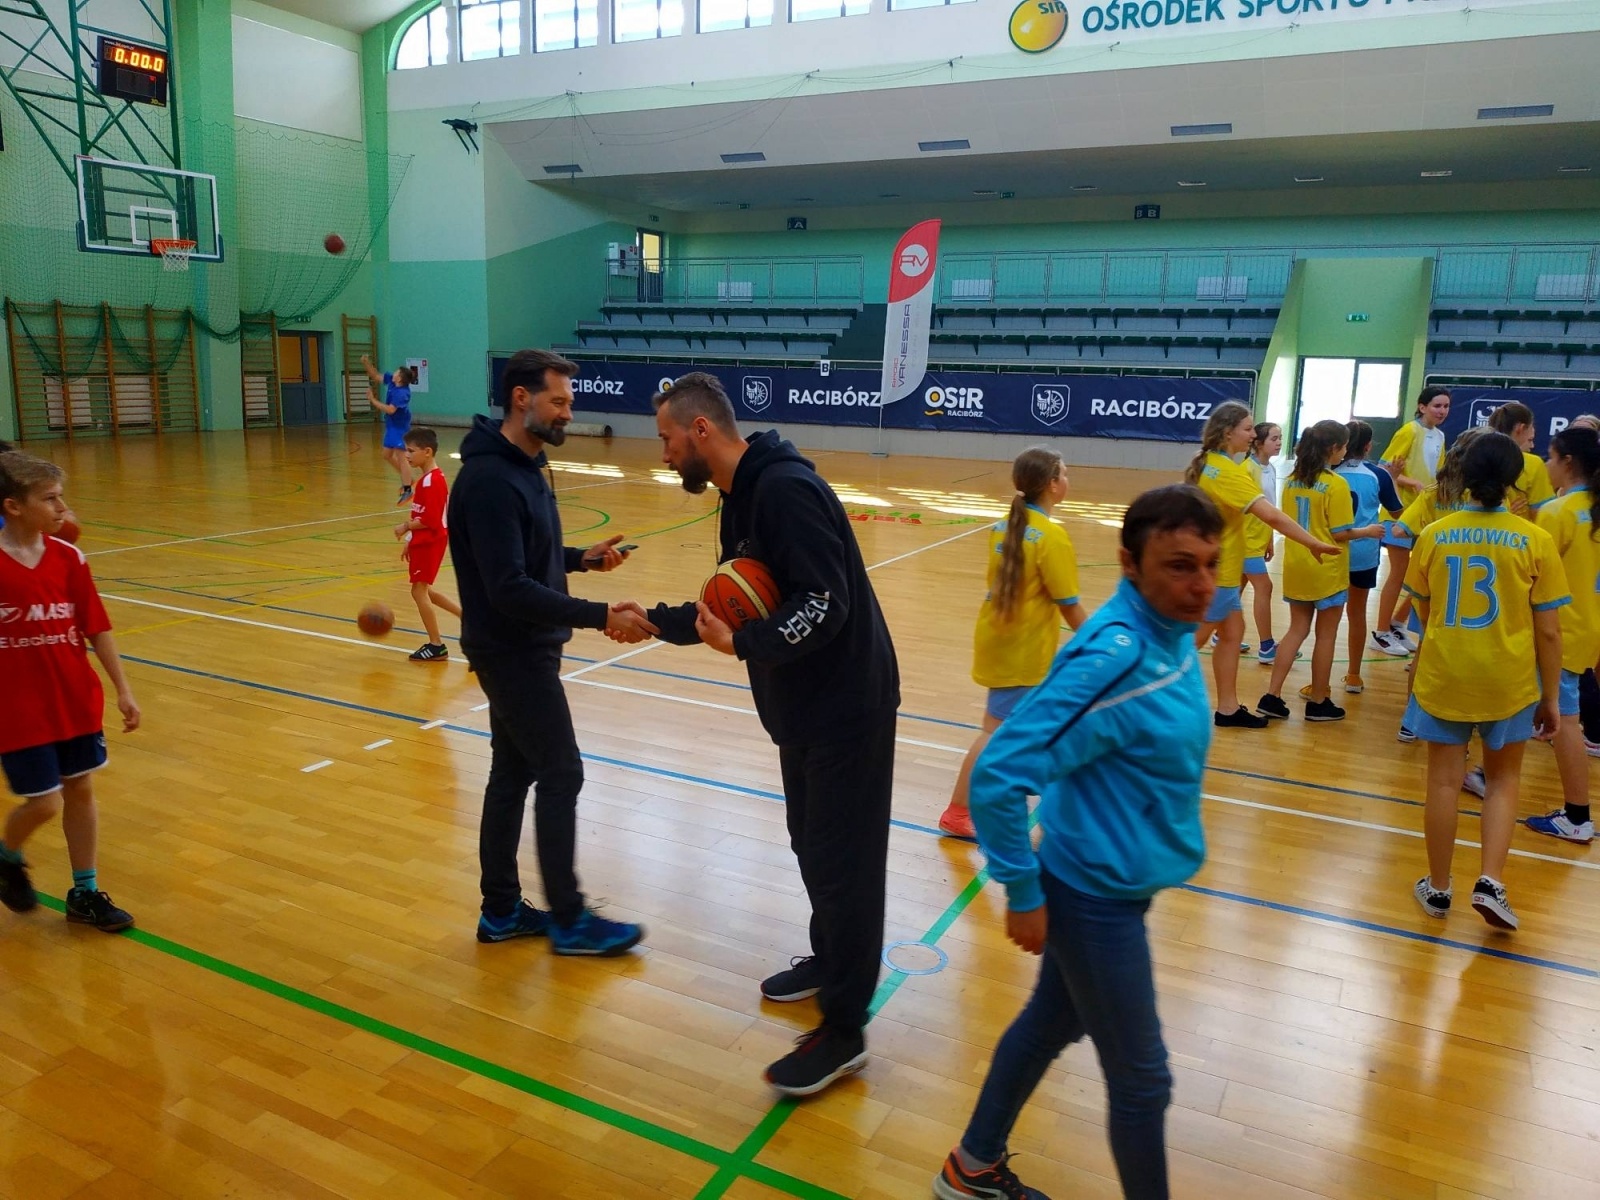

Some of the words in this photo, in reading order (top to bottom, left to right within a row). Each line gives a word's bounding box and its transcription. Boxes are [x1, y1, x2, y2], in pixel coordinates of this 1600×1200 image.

[1082, 0, 1225, 34] OŚRODEK
[1238, 0, 1367, 18] SPO
[898, 303, 911, 388] VANESSA
[821, 363, 829, 373] B
[570, 375, 624, 395] CIBÓRZ
[788, 385, 882, 407] RACIBÓRZ
[947, 409, 984, 418] RACIBÓRZ
[1090, 396, 1212, 420] RACIBÓRZ
[1444, 555, 1500, 629] 13
